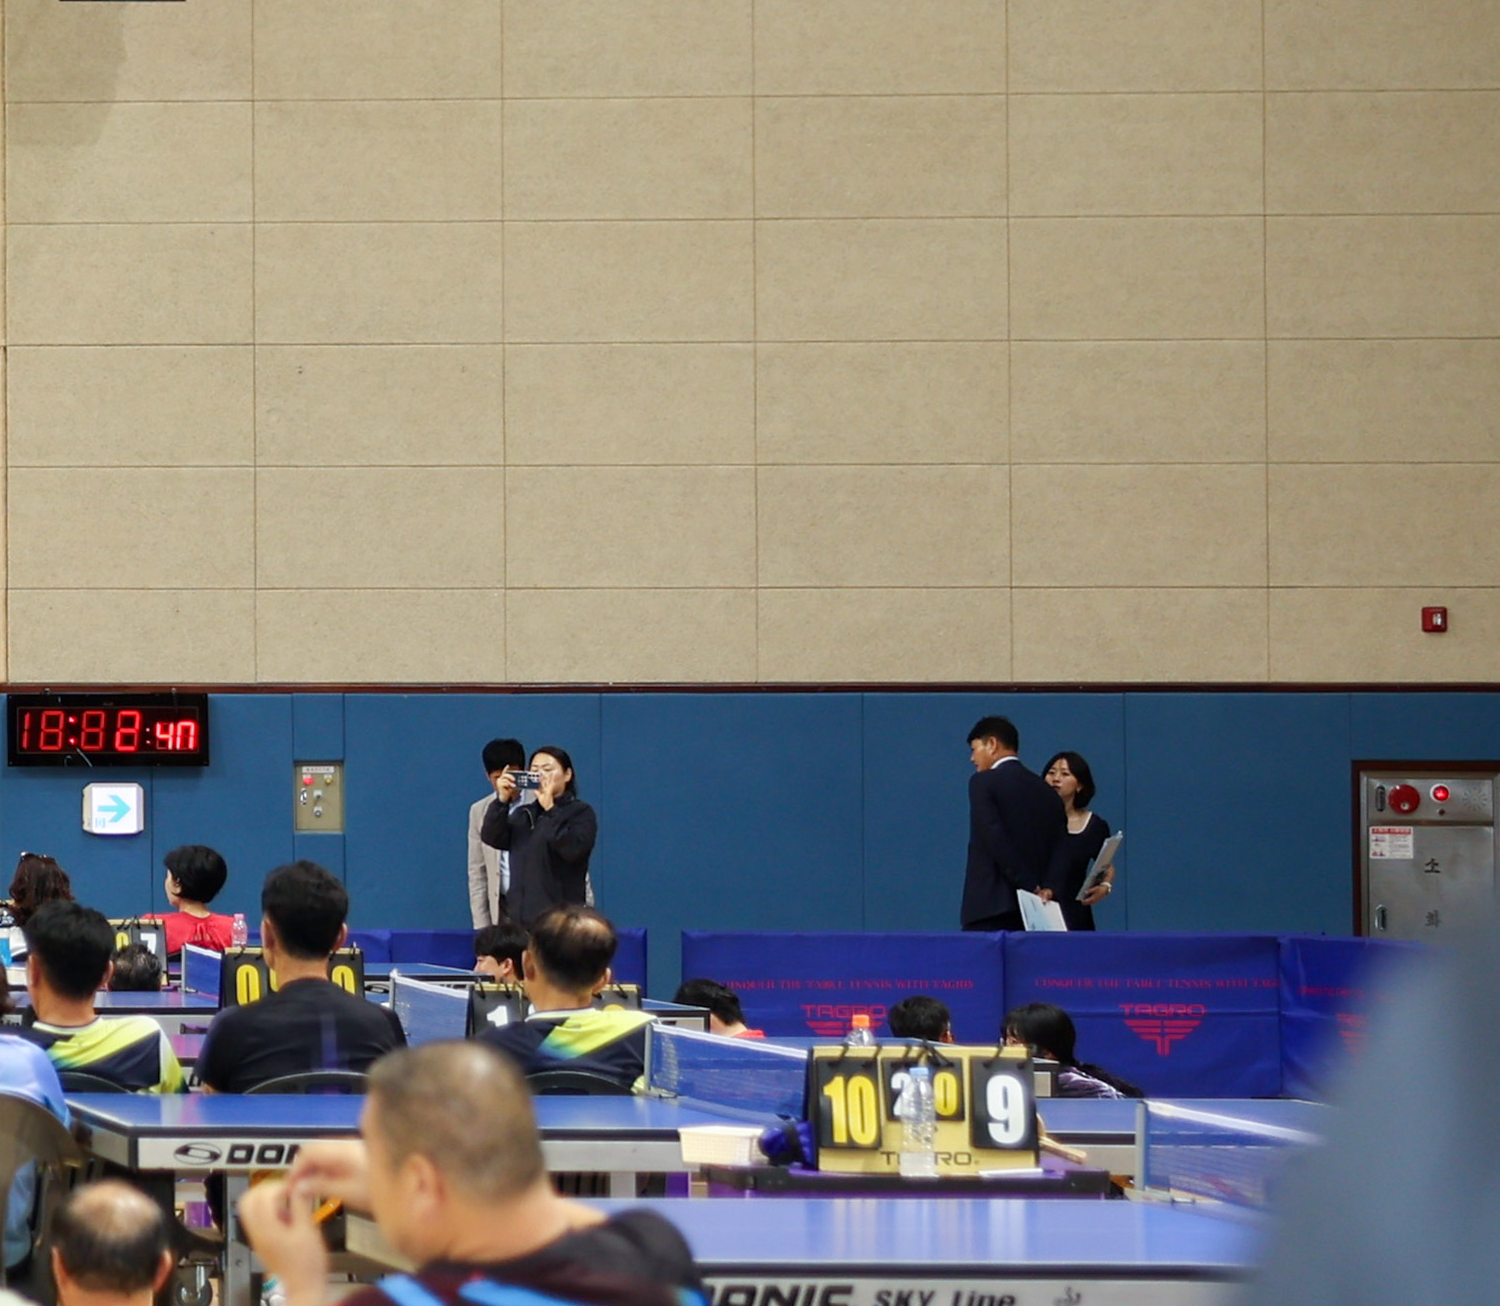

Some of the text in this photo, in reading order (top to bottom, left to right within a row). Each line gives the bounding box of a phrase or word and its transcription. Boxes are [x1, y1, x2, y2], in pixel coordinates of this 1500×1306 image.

[1119, 1003, 1207, 1017] TAGRO
[822, 1074, 876, 1145] 10
[987, 1074, 1028, 1145] 9
